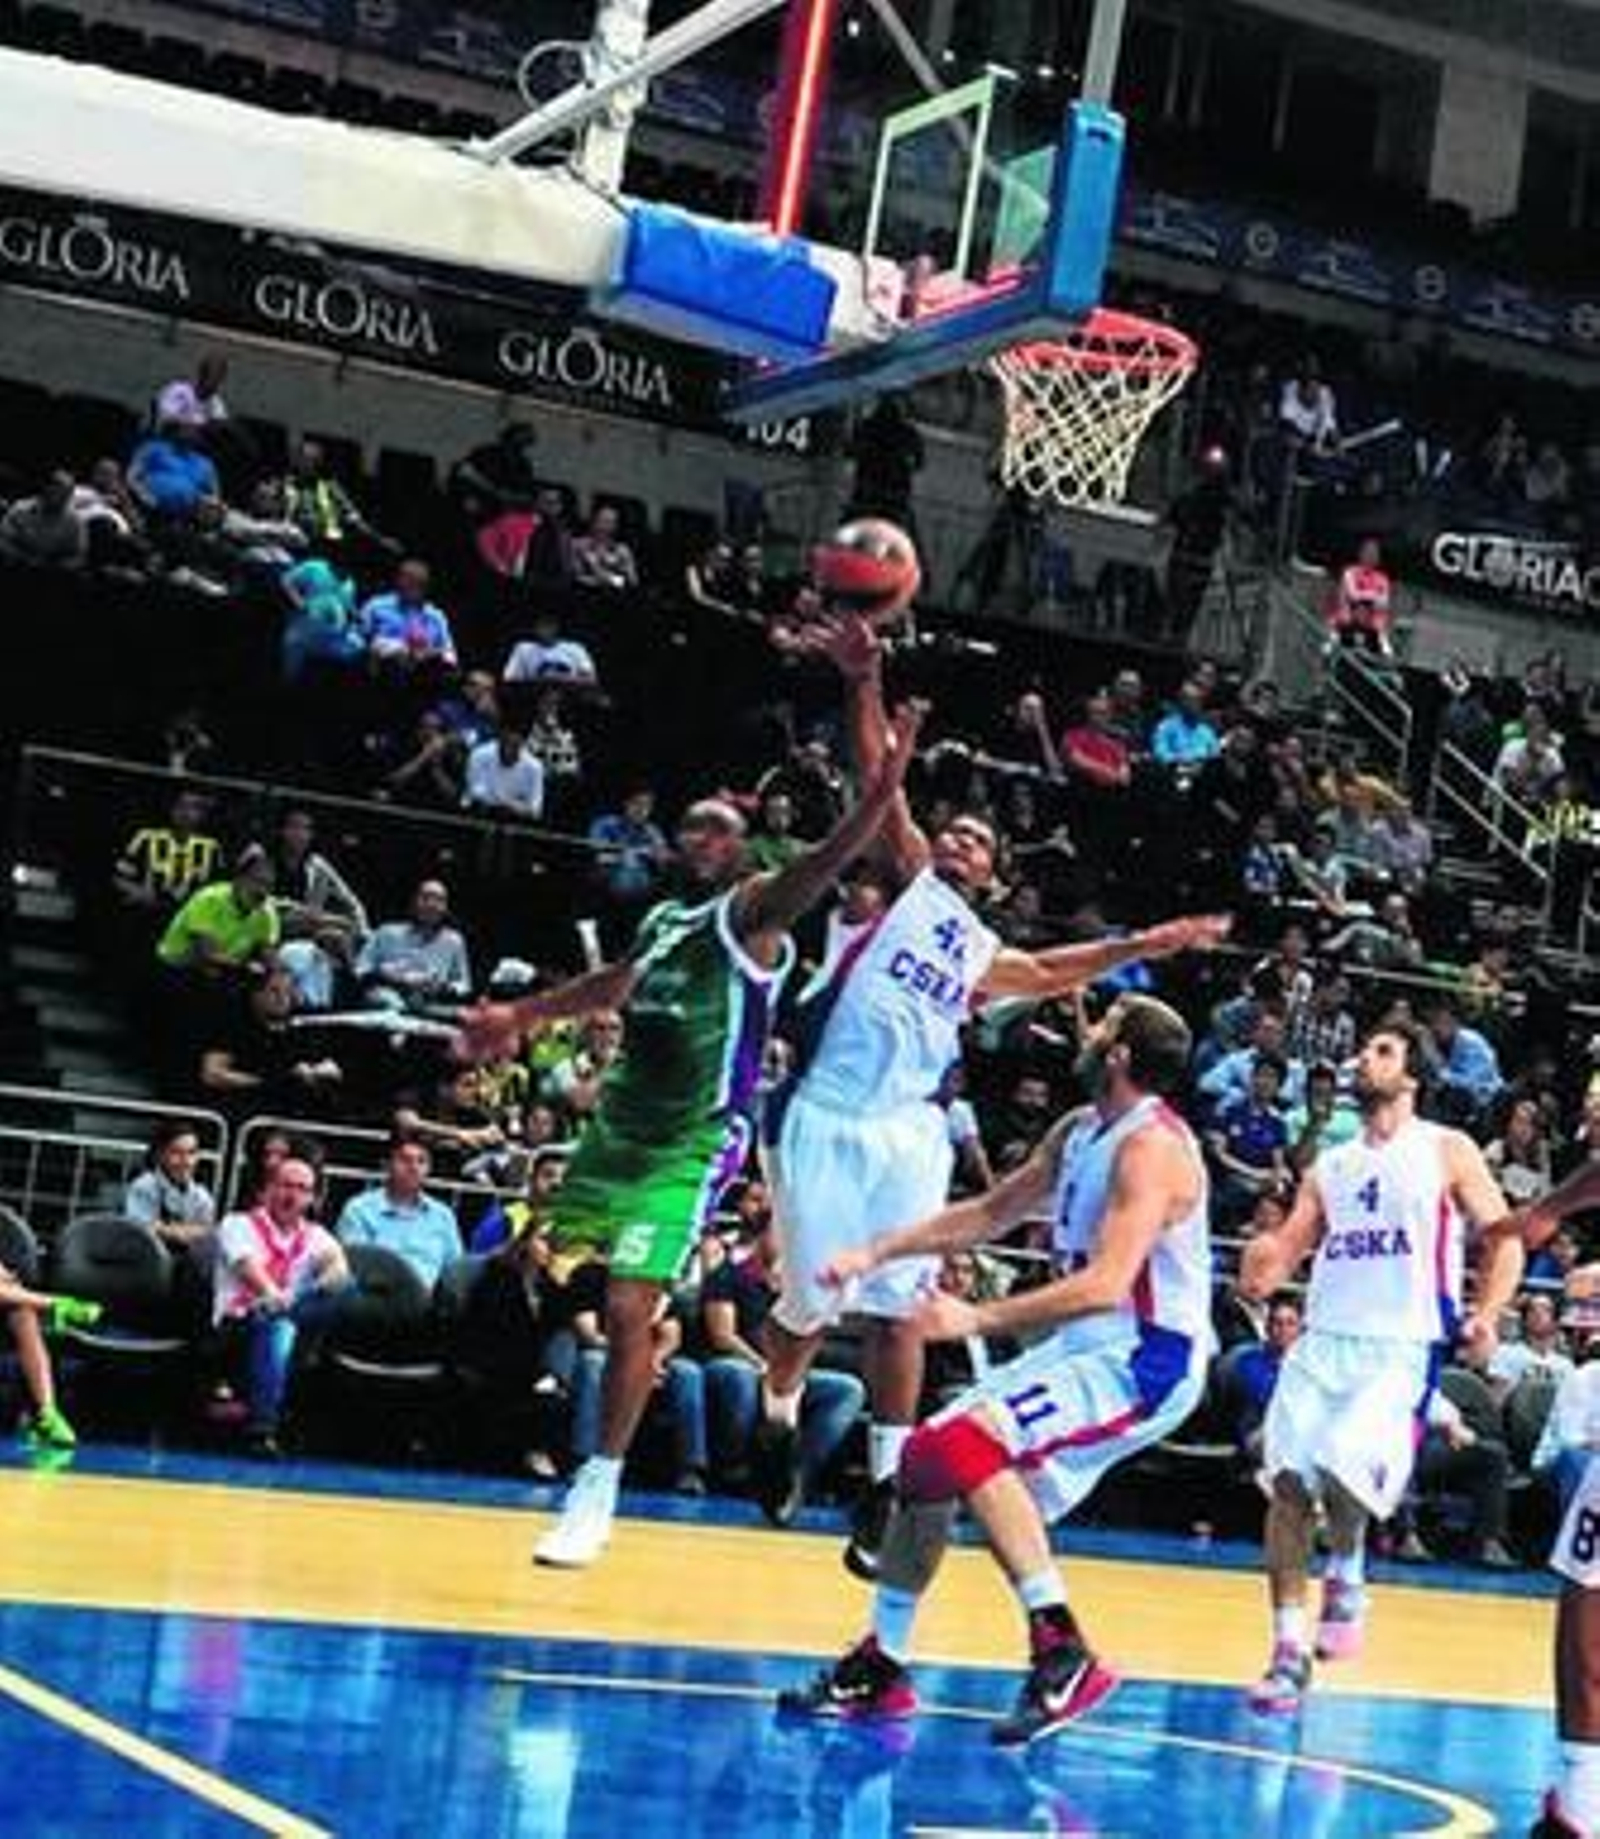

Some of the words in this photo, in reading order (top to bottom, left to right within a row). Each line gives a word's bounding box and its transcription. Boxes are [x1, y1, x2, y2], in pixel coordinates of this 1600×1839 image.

[0, 216, 190, 299] GLORIA
[255, 274, 438, 353] GLORIA
[499, 328, 671, 405] GLORIA
[747, 417, 810, 449] 04
[1356, 1177, 1379, 1212] 4
[1325, 1230, 1413, 1261] CSKA
[1005, 1384, 1057, 1427] 11
